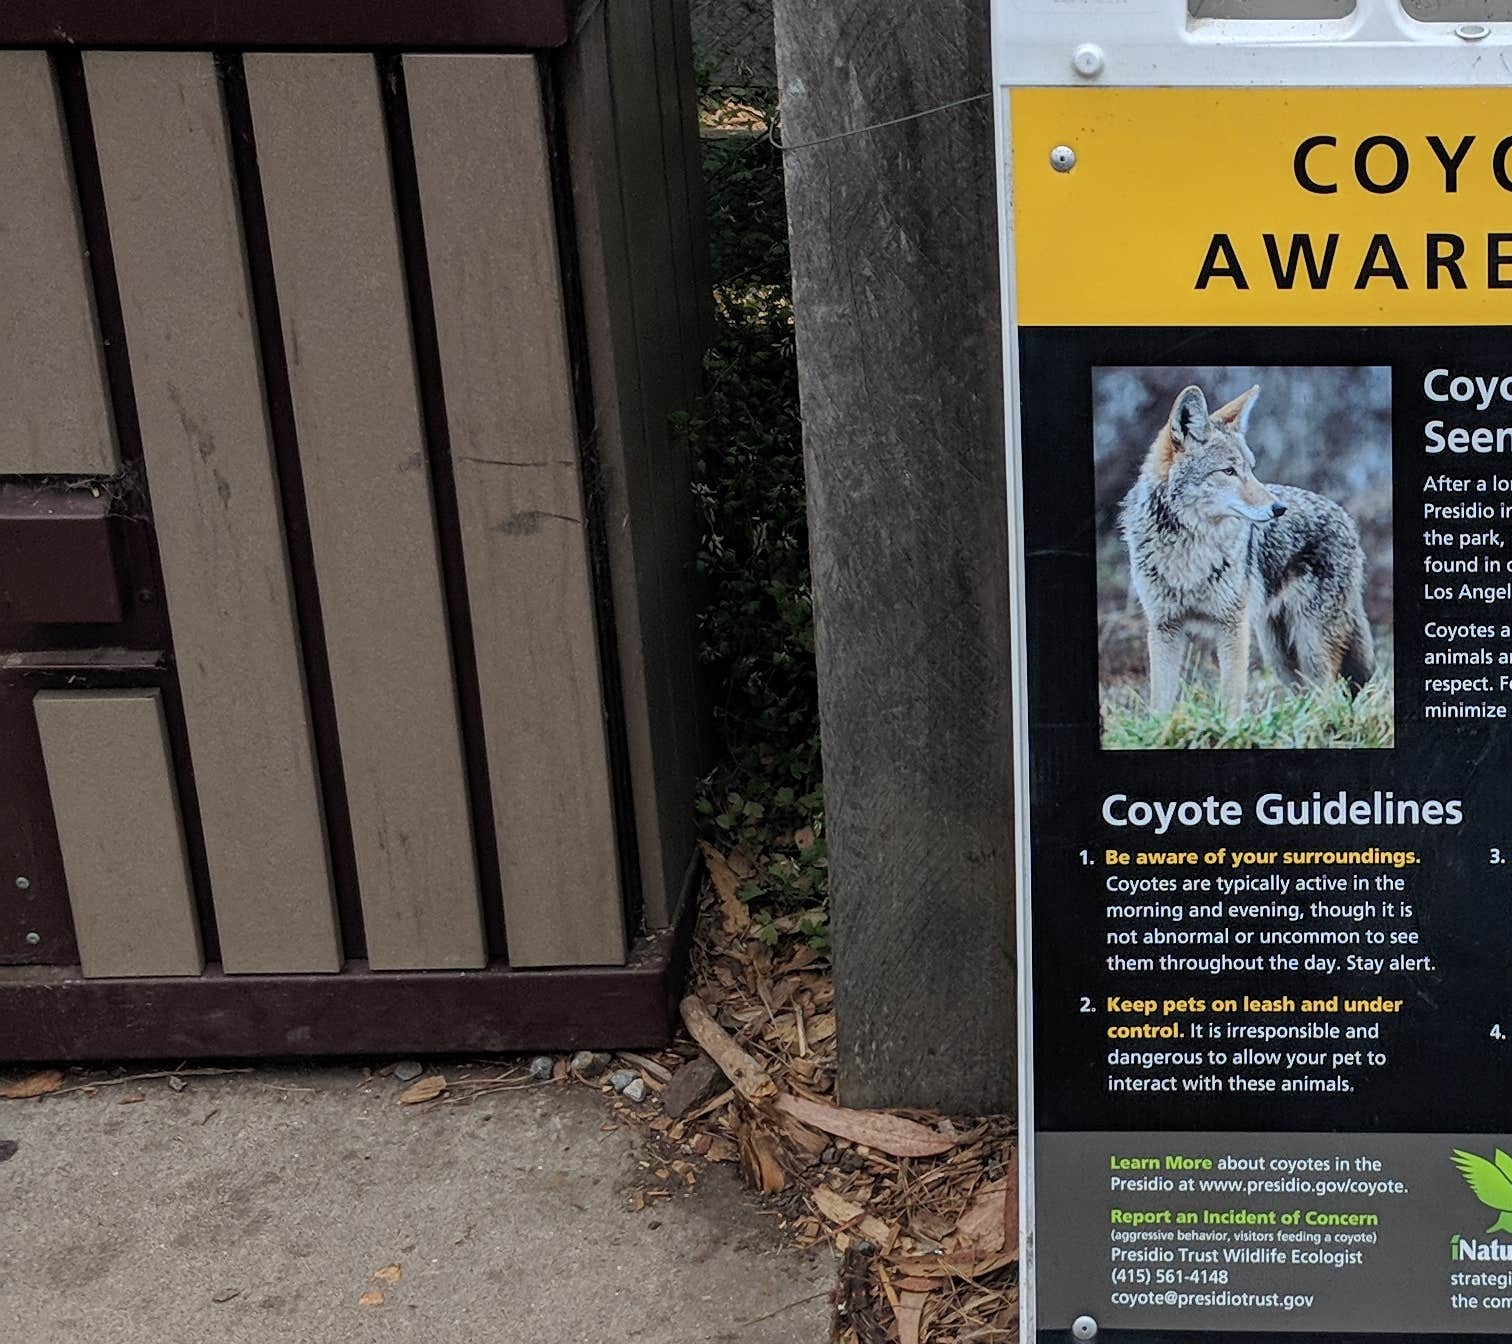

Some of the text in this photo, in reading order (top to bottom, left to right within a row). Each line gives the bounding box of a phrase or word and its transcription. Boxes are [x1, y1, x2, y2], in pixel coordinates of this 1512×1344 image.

[1423, 475, 1471, 492] After
[1476, 479, 1486, 491] a
[1424, 556, 1478, 573] found
[1484, 556, 1500, 572] in
[1424, 622, 1495, 642] Coyotes
[1102, 791, 1463, 834] Coyote Guidelines
[1080, 848, 1420, 868] 1. Be aware of your surroundings.
[1490, 848, 1505, 864] 3.
[1080, 996, 1403, 1016] 2. Keep pets on leash and under
[1107, 1022, 1379, 1042] control. It is irresponsible and
[1490, 1024, 1506, 1040] 4.
[1111, 1155, 1382, 1174] Learn More about coyotes in the
[1111, 1176, 1408, 1196] Presidio at www.presidio.gov/coyote.
[1111, 1209, 1378, 1226] Report an Incident of Concern
[1111, 1229, 1377, 1245] (aggressive behavior, visitors feeding a coyote)
[1112, 1247, 1363, 1268] Presidio Trust Wildlife Ecologist
[1112, 1268, 1228, 1285] (415) 561-4148
[1111, 1291, 1313, 1310] coyote@presidiotrust.gov
[1451, 1293, 1478, 1308] the
